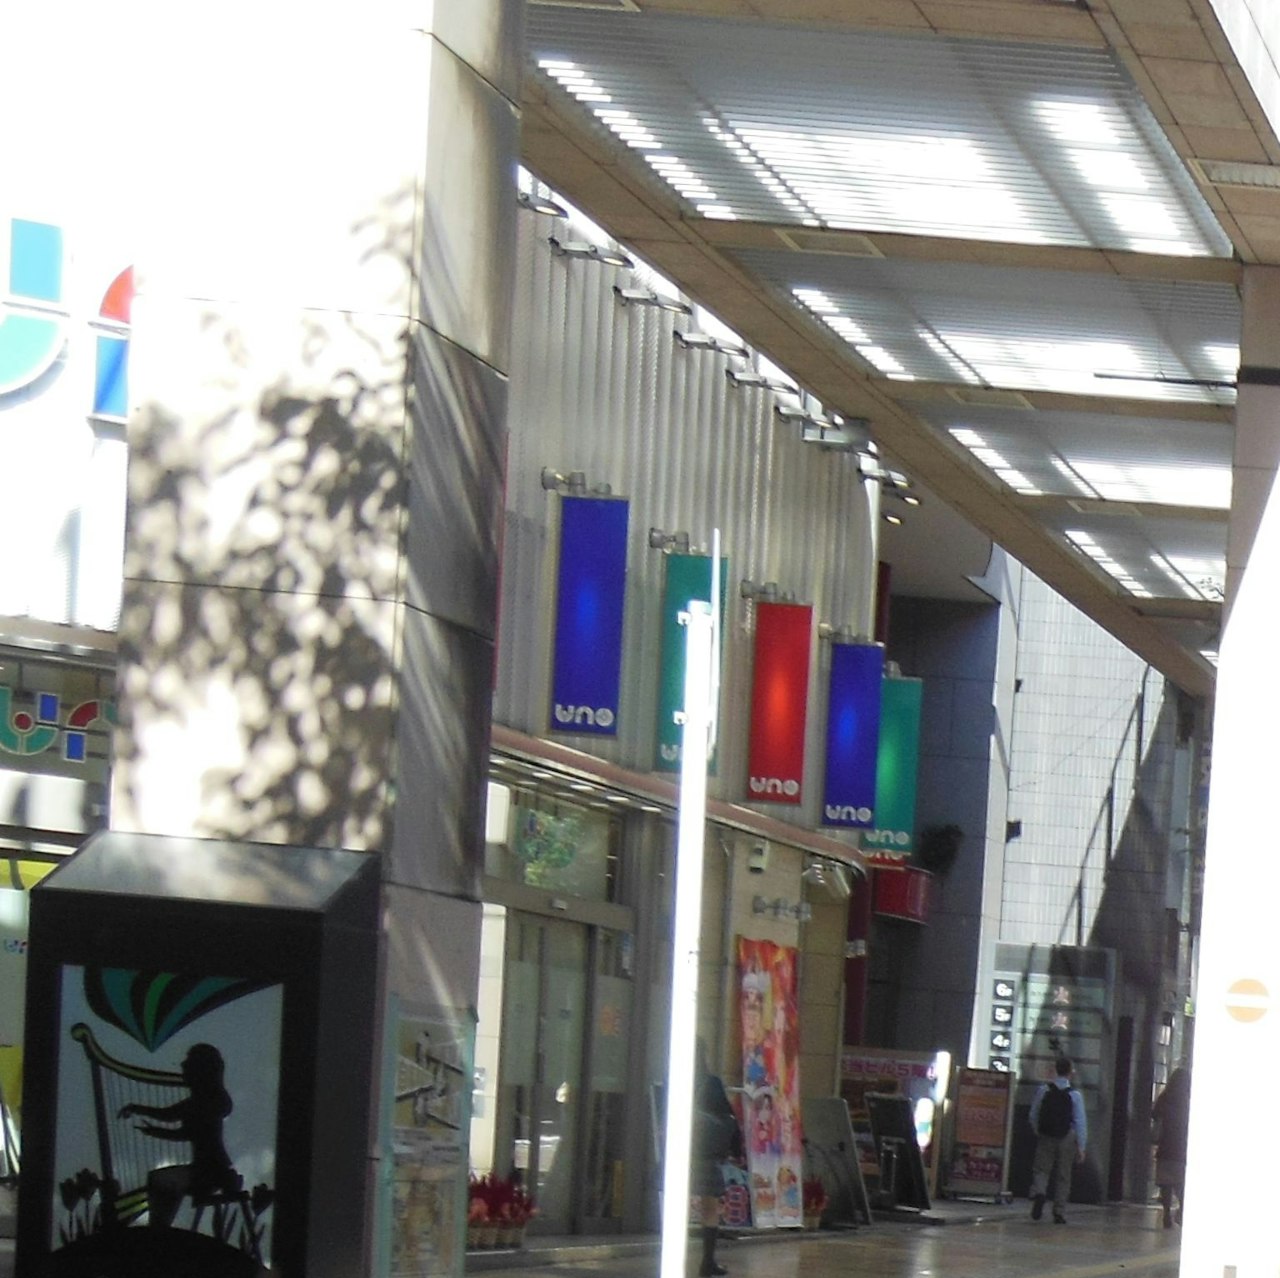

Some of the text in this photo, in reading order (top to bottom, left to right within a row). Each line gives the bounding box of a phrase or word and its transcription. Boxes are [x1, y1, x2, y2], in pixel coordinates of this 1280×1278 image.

[555, 704, 614, 727] uno
[750, 777, 799, 796] uno
[825, 804, 872, 822] uno
[996, 983, 1013, 997] 6F
[995, 1008, 1011, 1022] 5F
[992, 1034, 1010, 1048] 4F
